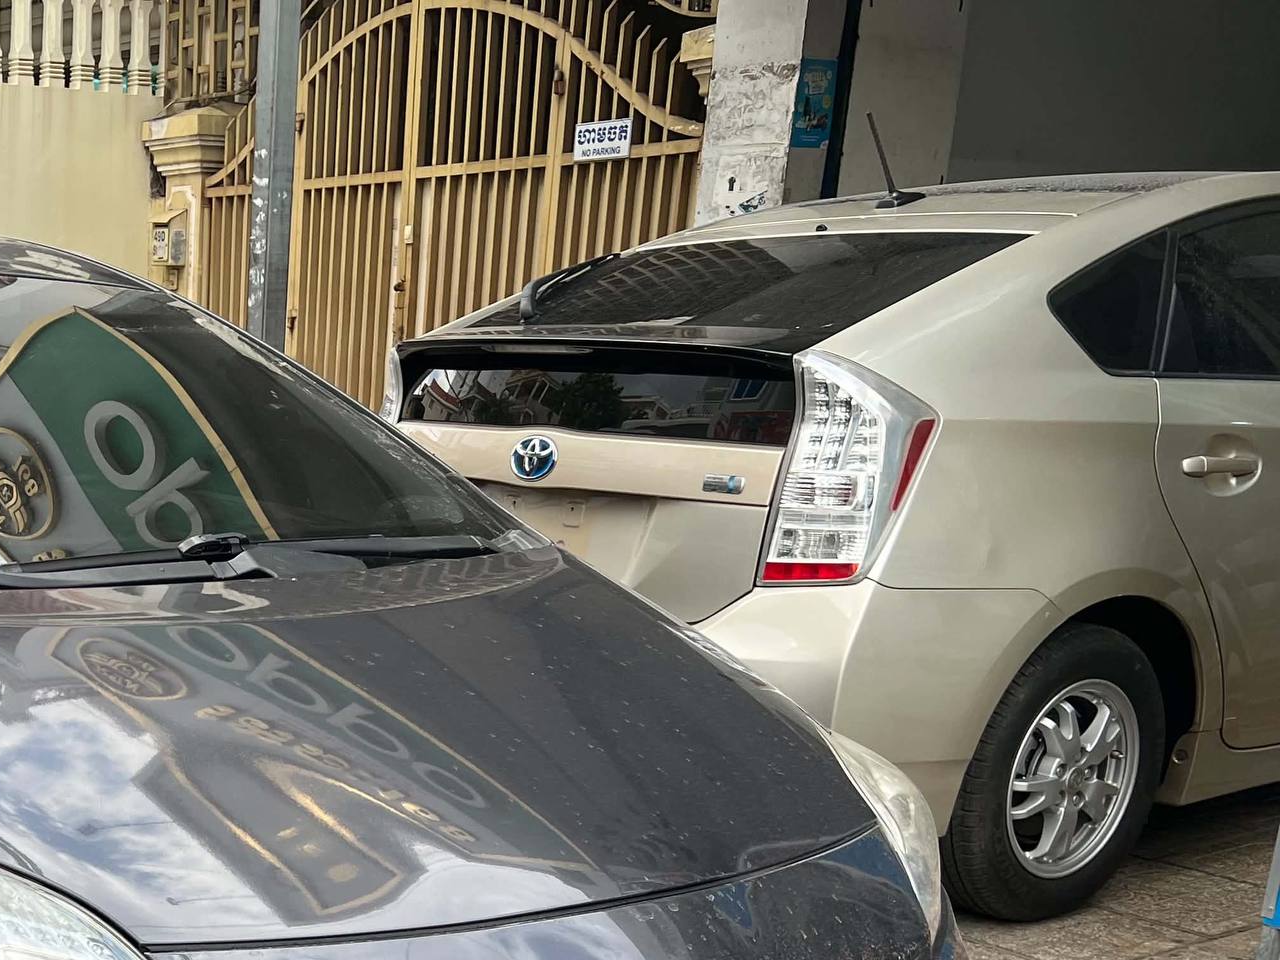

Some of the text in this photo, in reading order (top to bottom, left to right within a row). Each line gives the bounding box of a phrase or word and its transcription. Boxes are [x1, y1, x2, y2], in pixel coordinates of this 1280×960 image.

[577, 124, 629, 145] ហាមចត
[581, 146, 621, 157] NO PARKING
